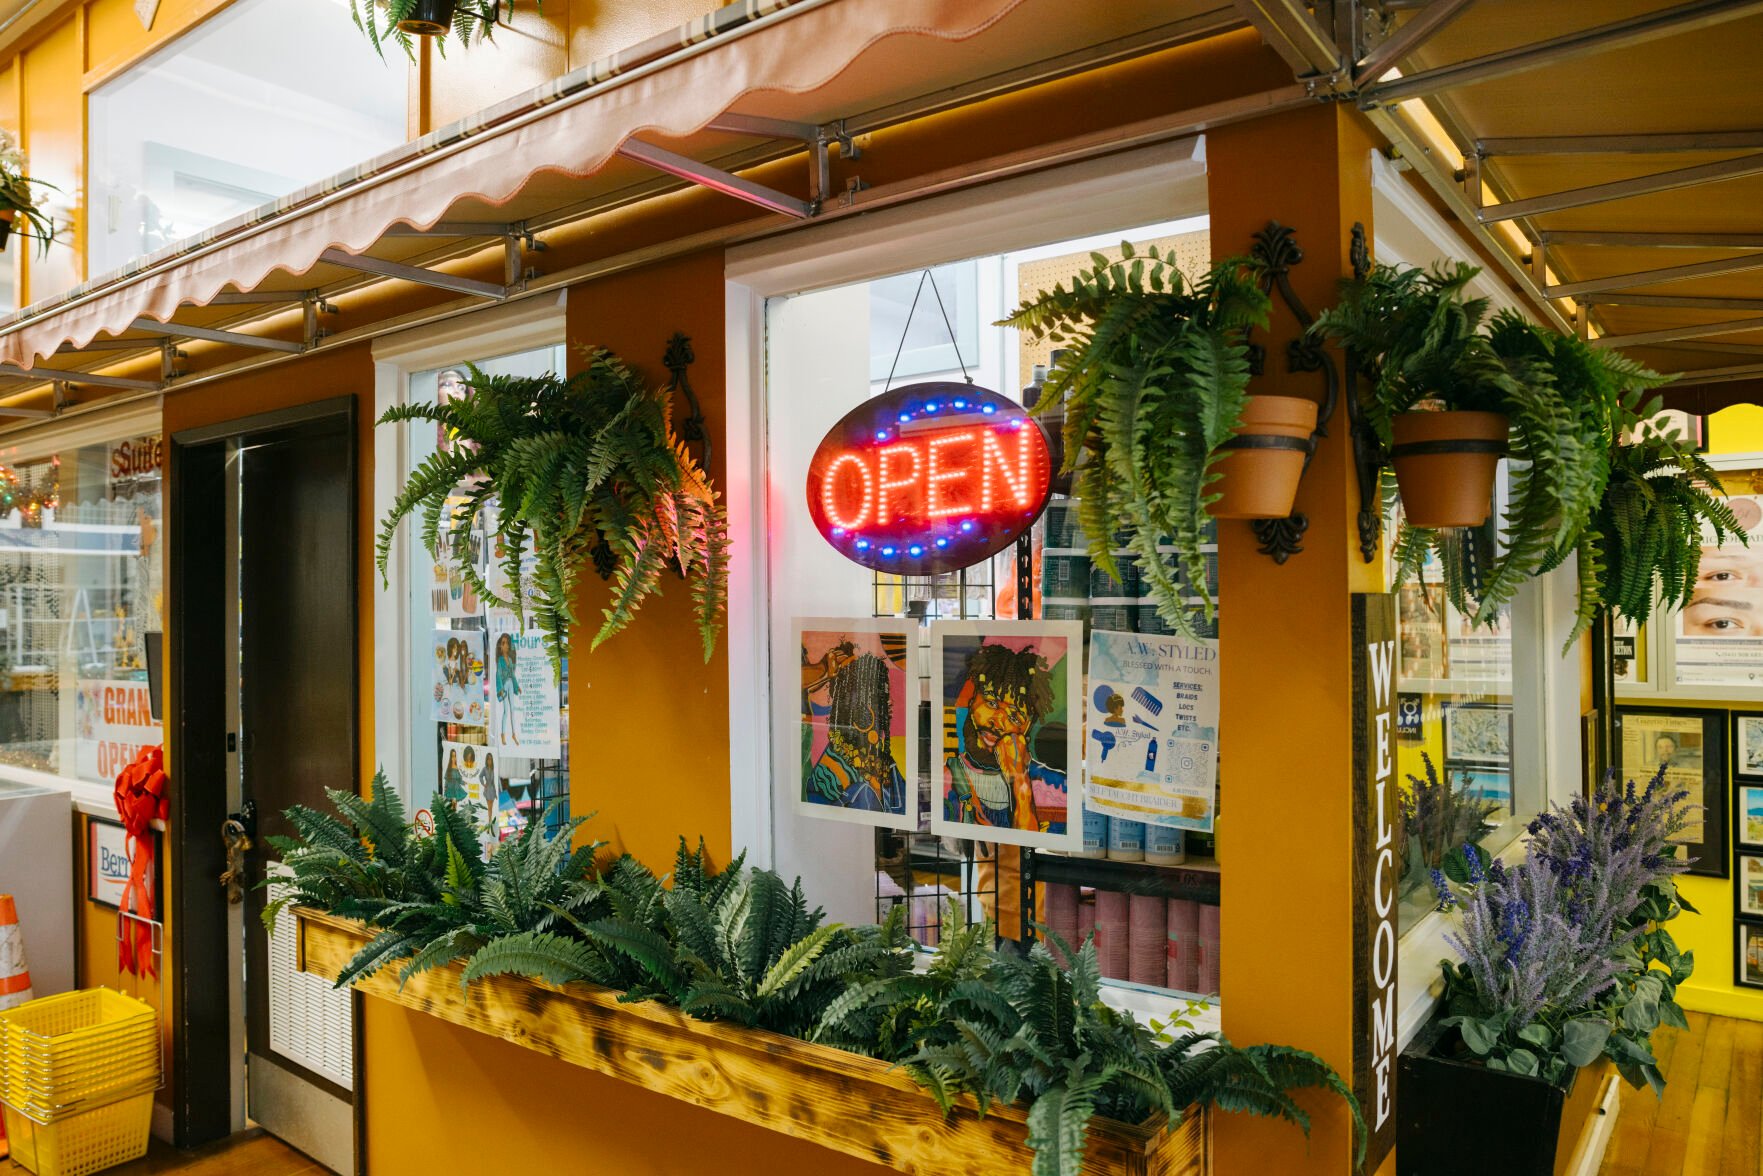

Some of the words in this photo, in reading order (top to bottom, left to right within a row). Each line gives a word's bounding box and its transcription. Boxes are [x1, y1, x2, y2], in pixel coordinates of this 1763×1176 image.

[823, 422, 1031, 530] OPEN
[1158, 643, 1216, 661] STYLED
[1122, 660, 1153, 670] BLESSED
[1154, 663, 1175, 673] WITH
[1176, 665, 1182, 673] A
[1176, 693, 1198, 701] BRAIDS
[104, 687, 162, 727] GRAN
[1176, 714, 1197, 722] TWISTS
[1368, 640, 1396, 1134] WELCOME
